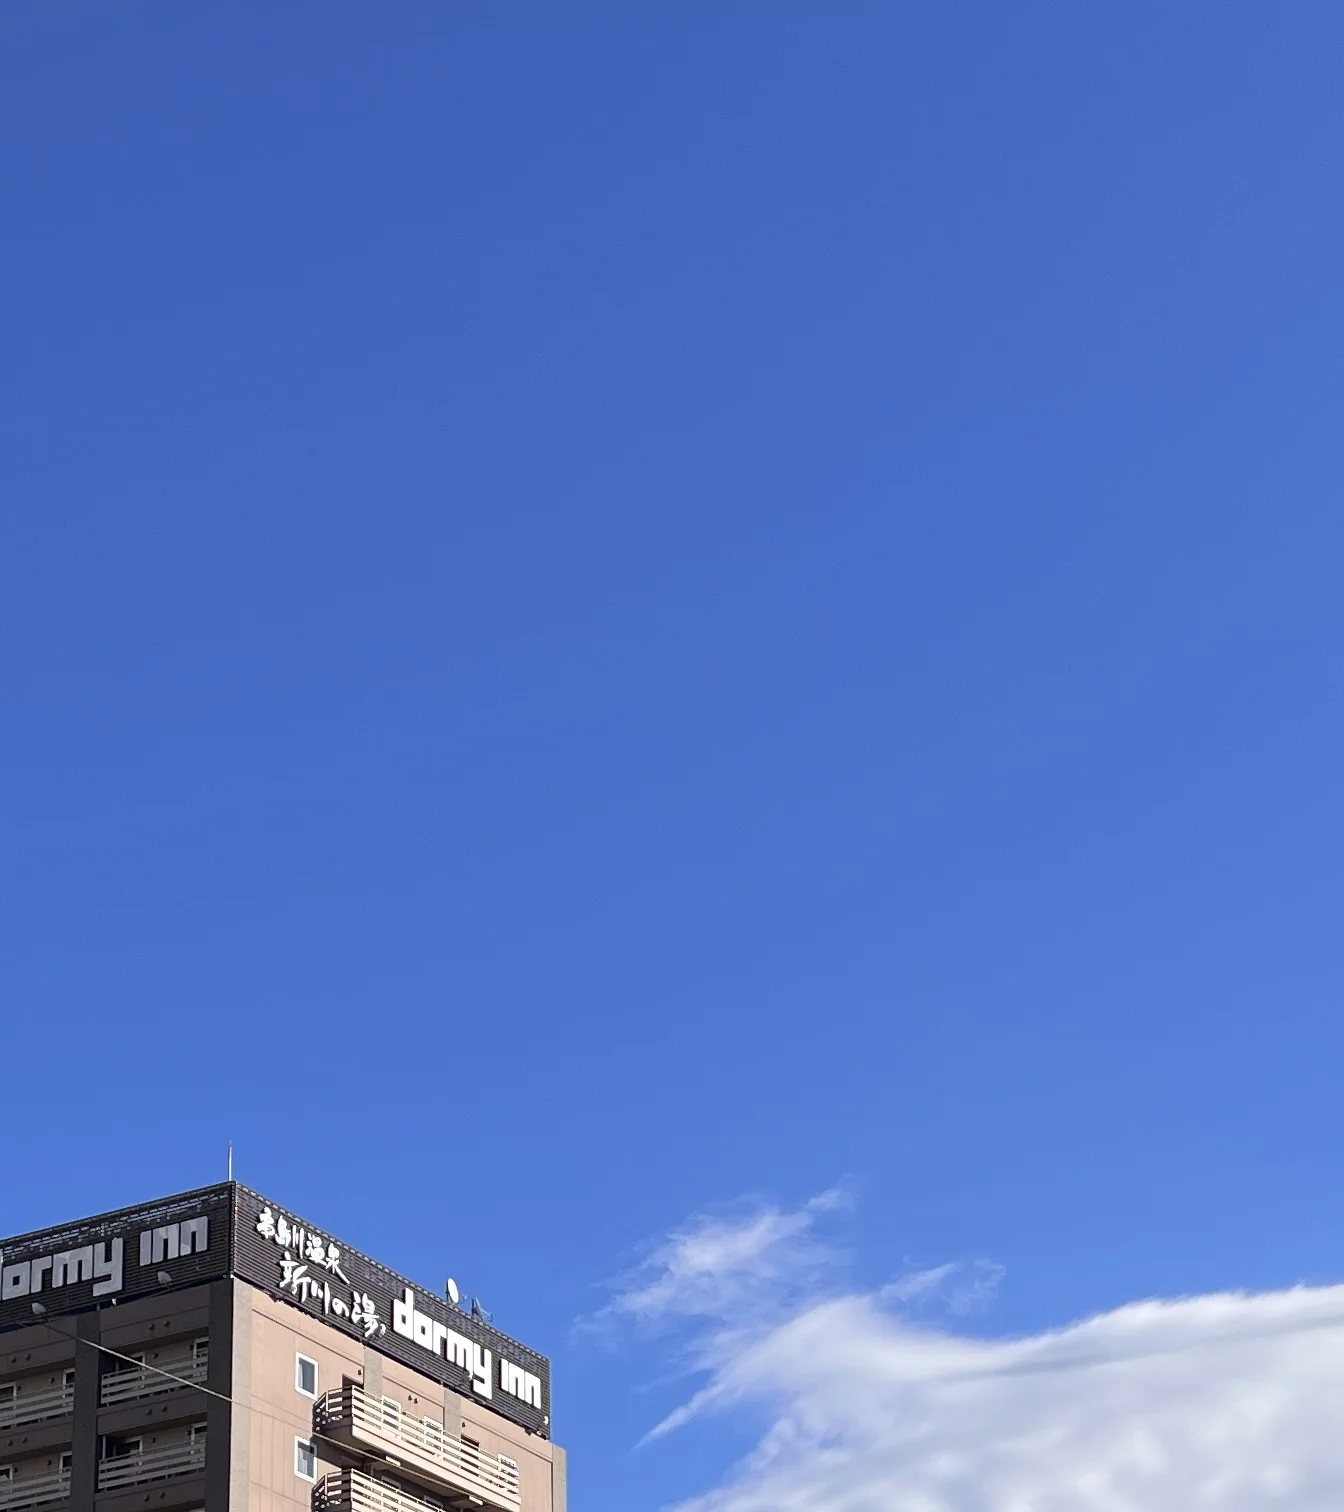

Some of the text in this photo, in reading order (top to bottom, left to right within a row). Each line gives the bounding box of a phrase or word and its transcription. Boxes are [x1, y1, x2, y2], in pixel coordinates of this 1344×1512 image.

[139, 1216, 208, 1267] inn
[279, 1251, 381, 1338] 新川の湯
[392, 1287, 542, 1410] dormy inn
